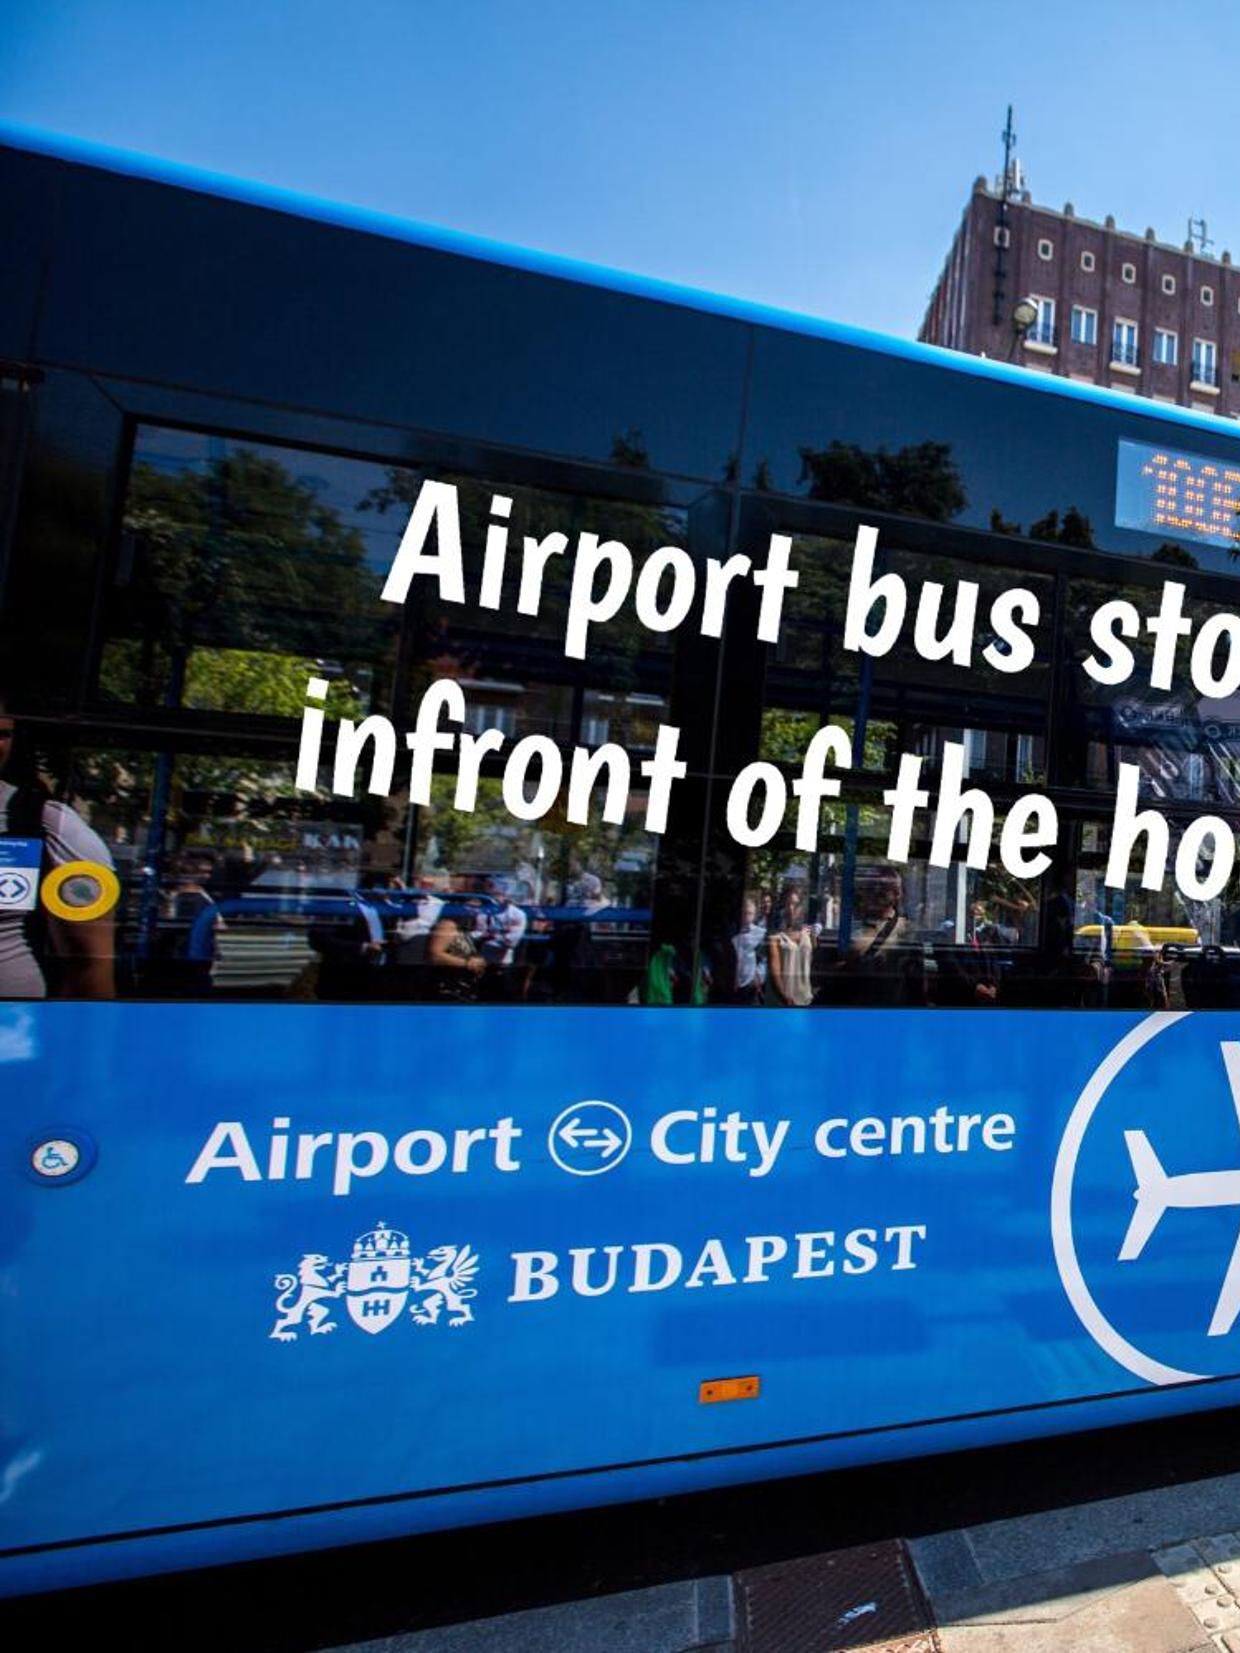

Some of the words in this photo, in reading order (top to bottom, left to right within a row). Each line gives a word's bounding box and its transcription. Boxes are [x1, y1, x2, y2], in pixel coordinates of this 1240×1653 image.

[185, 1117, 521, 1196] Airport
[651, 1107, 790, 1177] City
[815, 1107, 1015, 1159] centre
[508, 1225, 926, 1303] BUDAPEST
